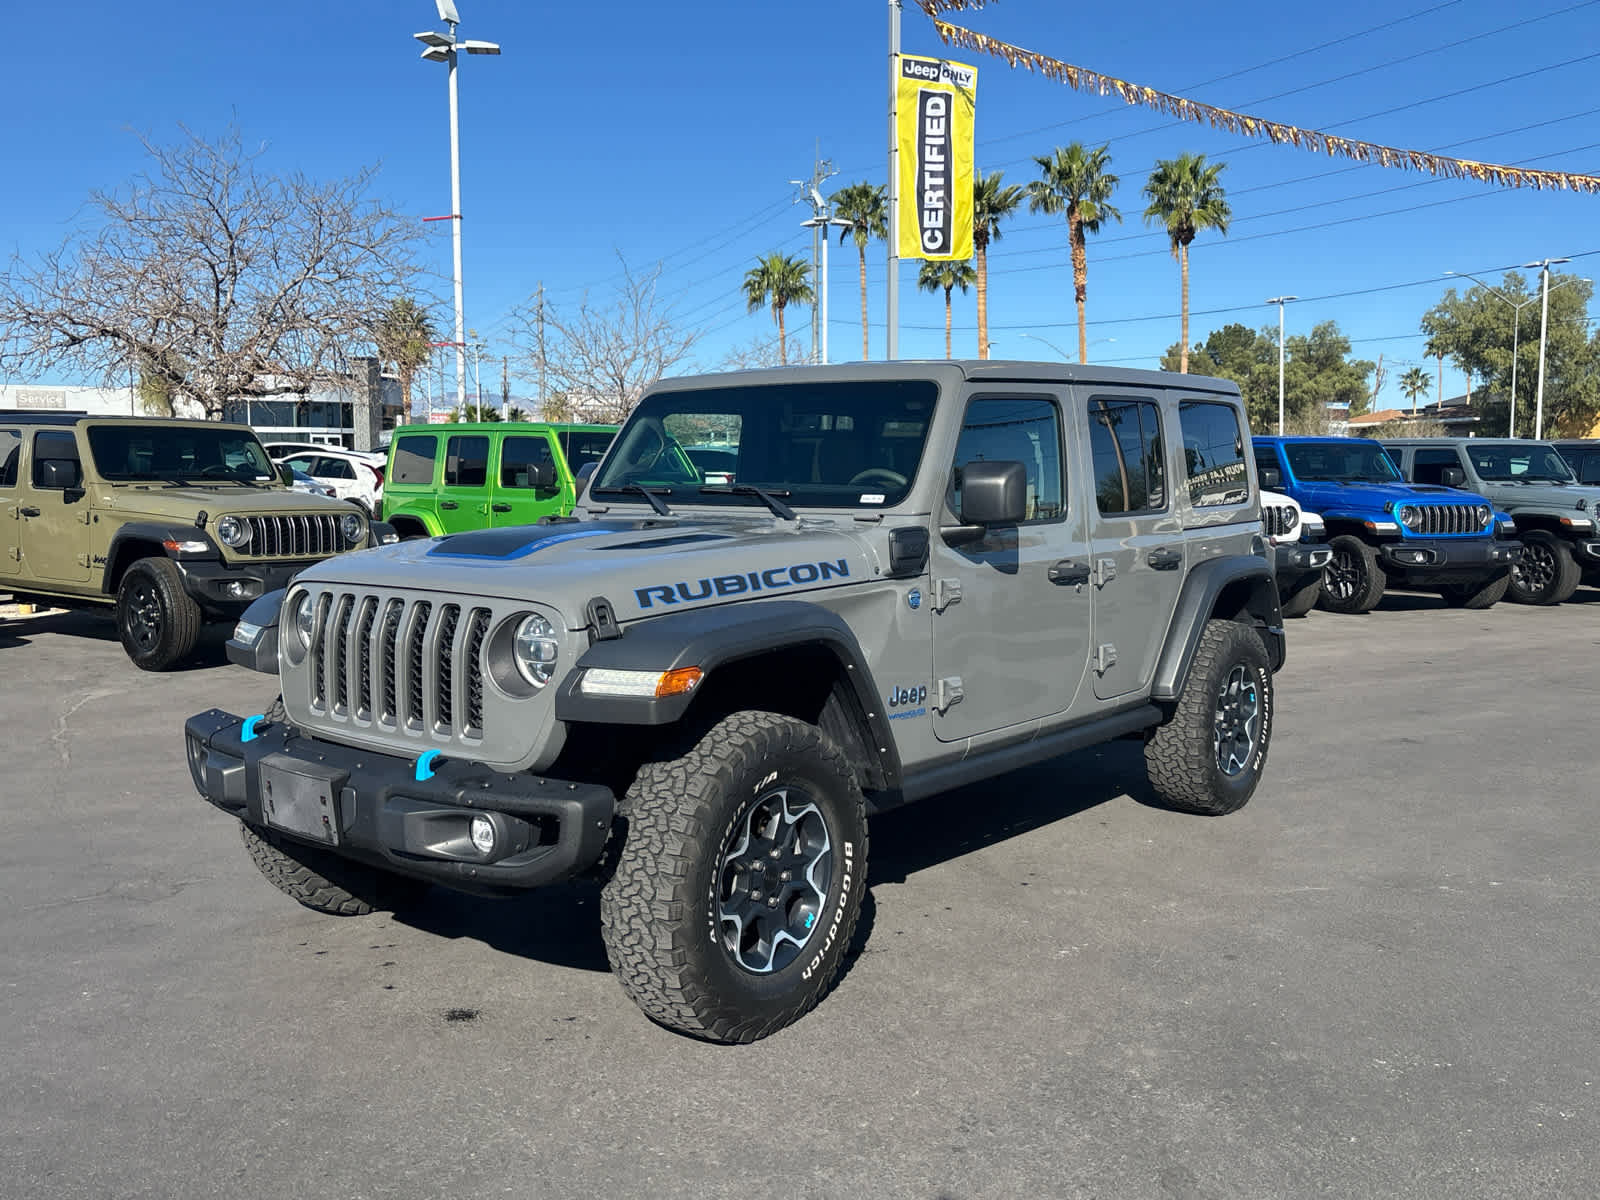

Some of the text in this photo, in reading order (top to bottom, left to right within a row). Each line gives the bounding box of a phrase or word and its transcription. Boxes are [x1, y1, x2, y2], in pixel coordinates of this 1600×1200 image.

[905, 61, 972, 83] Jeep ONLY
[923, 96, 946, 250] CERTIFIED
[18, 393, 64, 404] Service
[633, 559, 850, 608] RUBICON
[888, 685, 927, 707] Jeep
[802, 841, 854, 980] BFGoodrich
